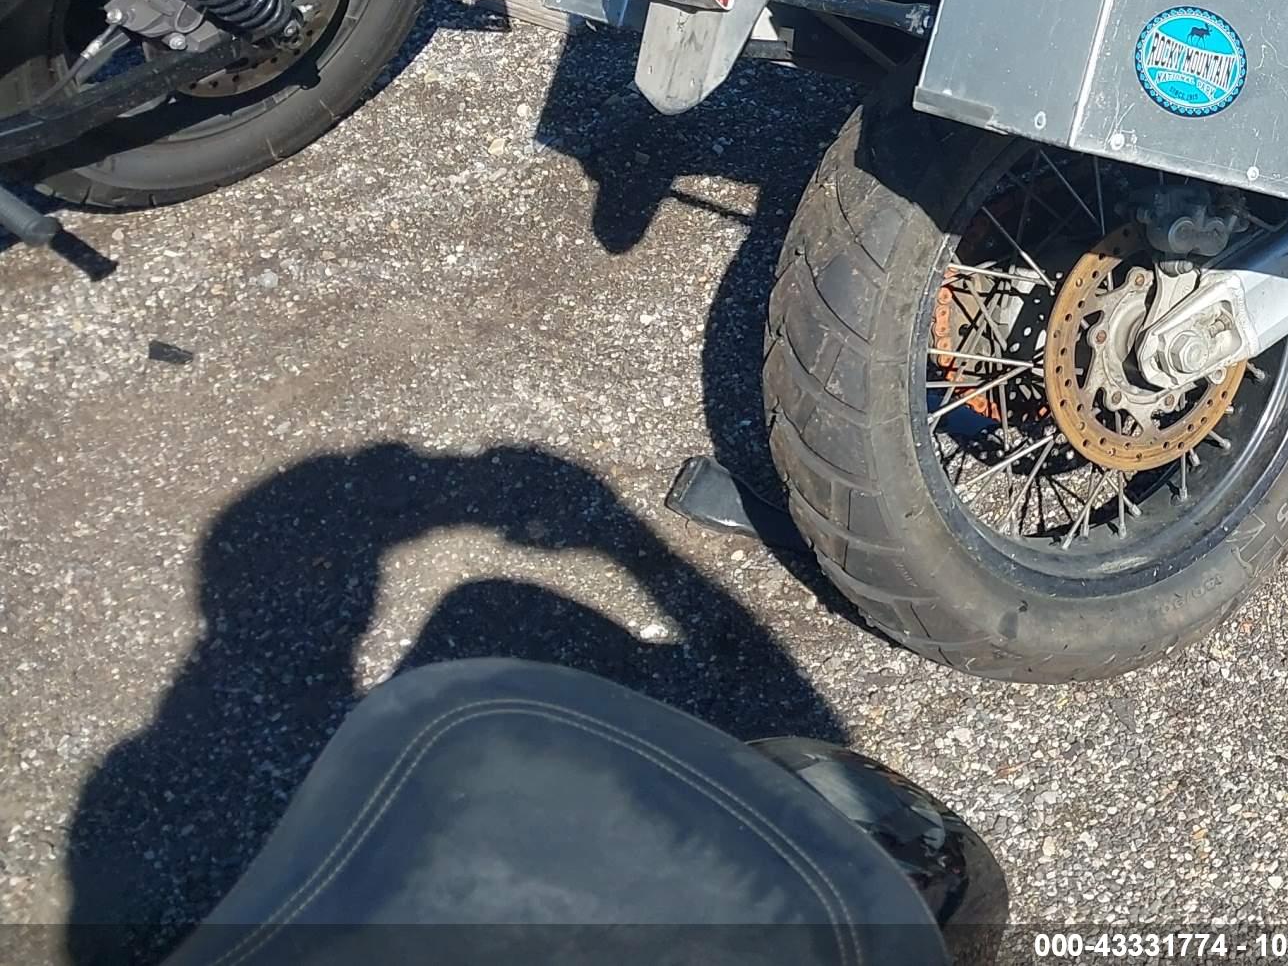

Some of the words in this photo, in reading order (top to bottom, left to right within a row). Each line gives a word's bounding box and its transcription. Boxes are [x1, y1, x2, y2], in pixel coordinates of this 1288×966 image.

[1147, 32, 1185, 70] ROCKY
[1182, 46, 1236, 91] MOUNTAIN
[1157, 71, 1196, 85] NATIONAL
